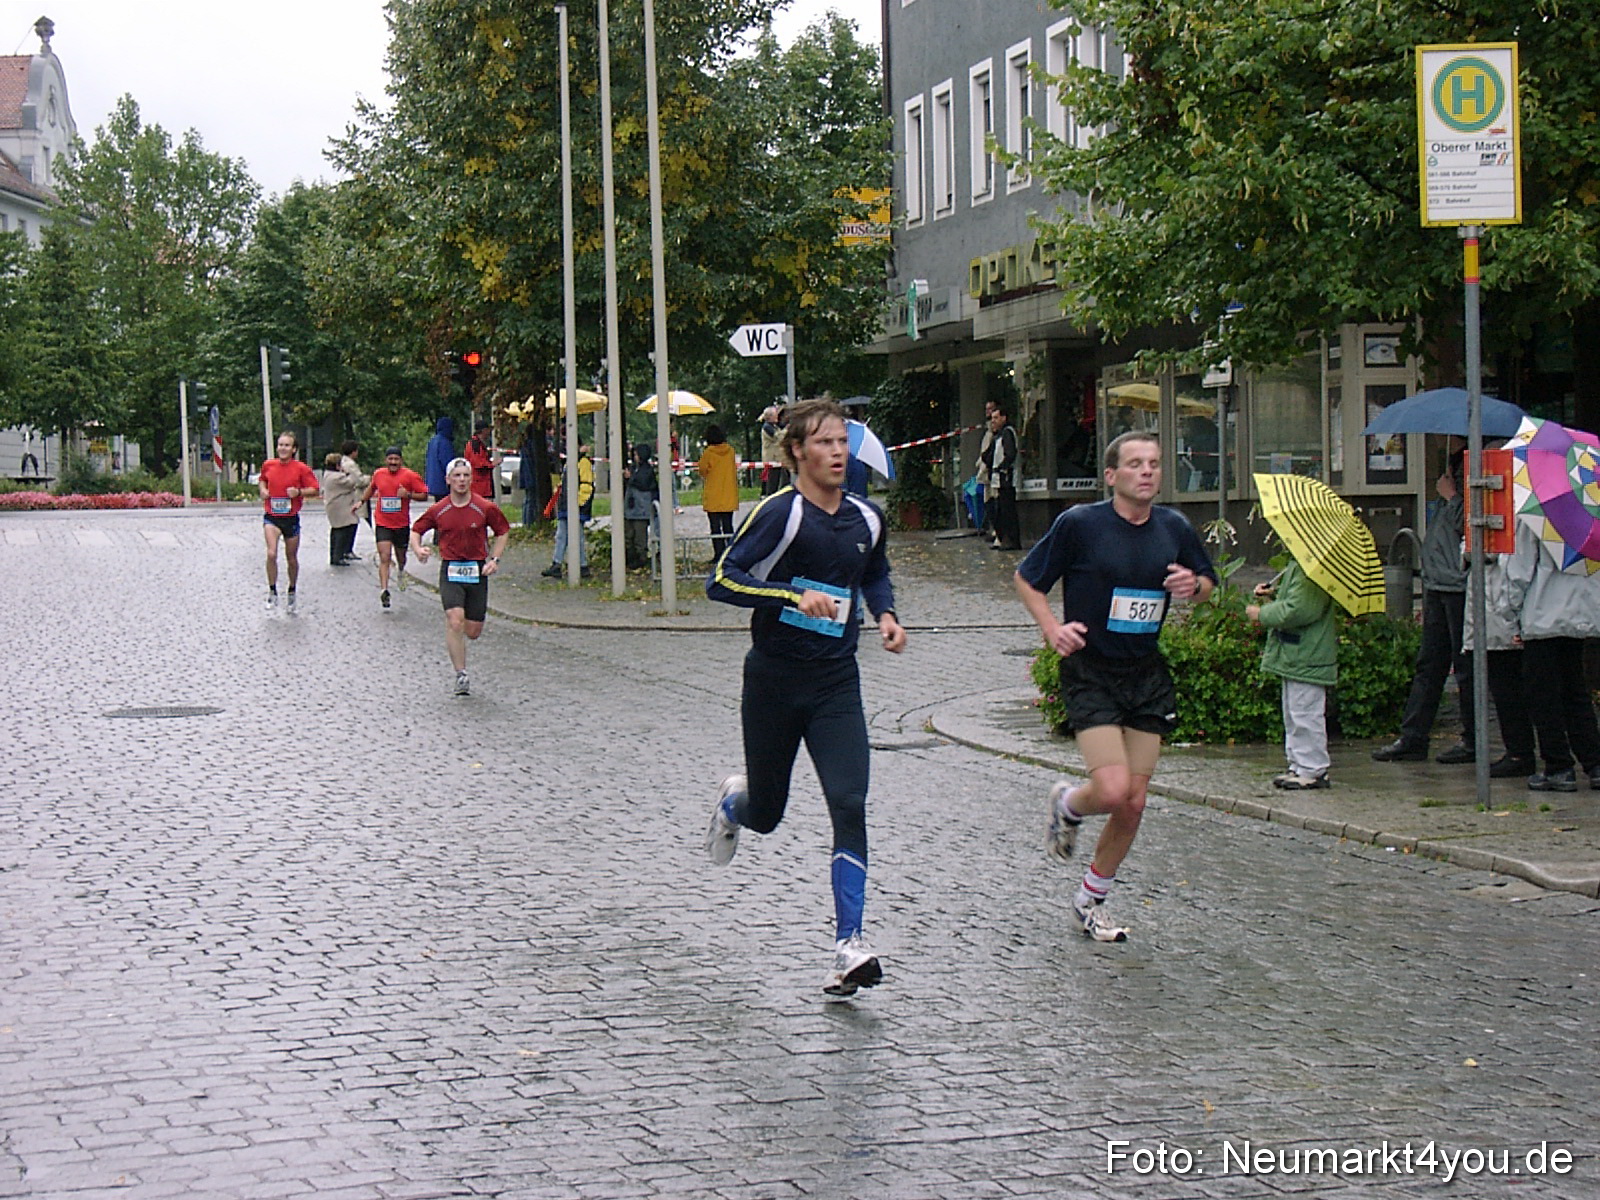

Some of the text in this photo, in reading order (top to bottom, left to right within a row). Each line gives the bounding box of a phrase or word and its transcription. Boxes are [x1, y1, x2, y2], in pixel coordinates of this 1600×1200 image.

[1451, 75, 1486, 115] H
[1431, 141, 1507, 153] Oberer Markt
[745, 328, 779, 352] WC
[457, 567, 474, 576] 407
[1128, 601, 1158, 620] 587
